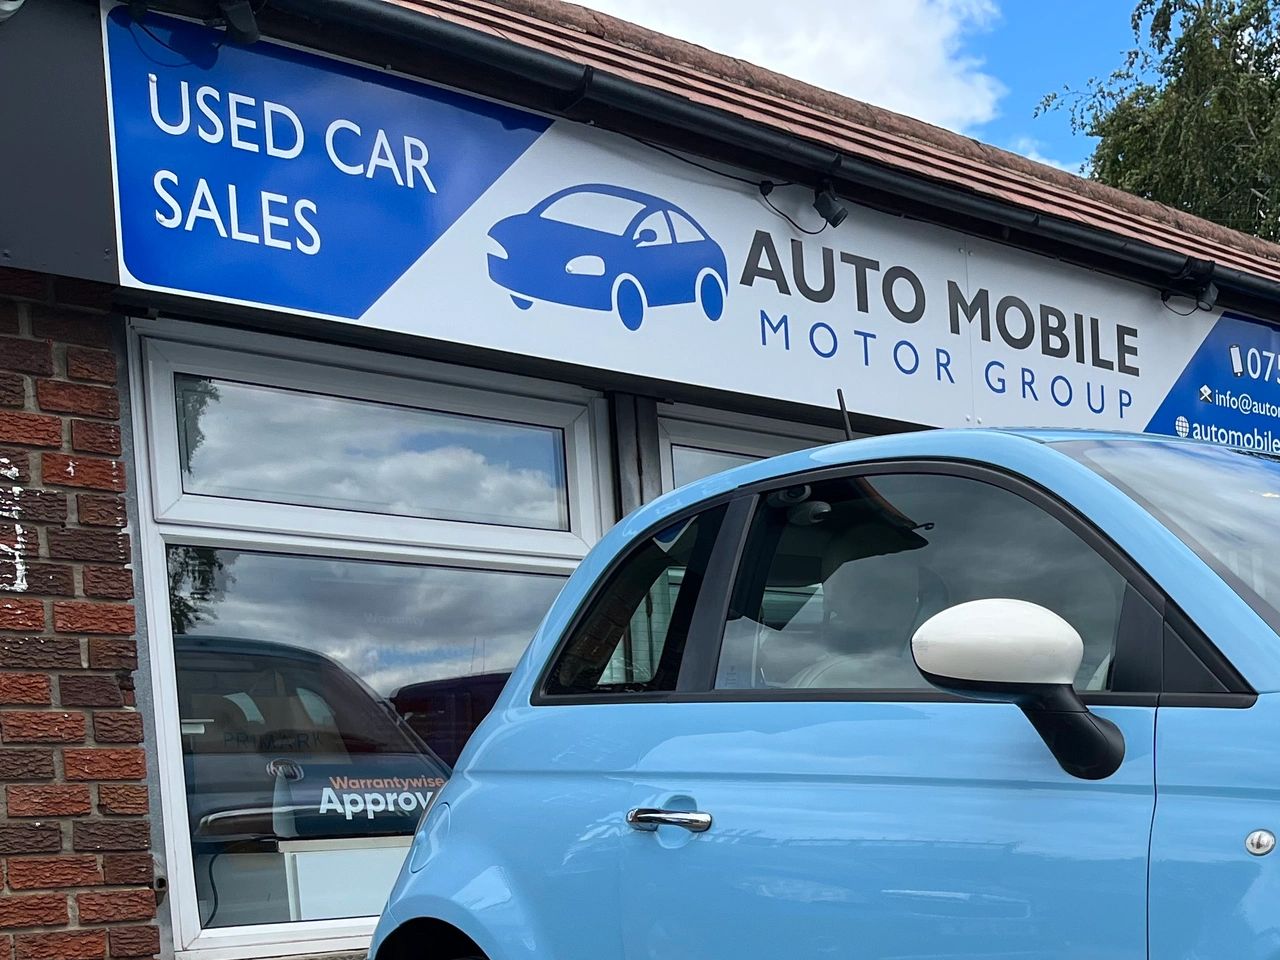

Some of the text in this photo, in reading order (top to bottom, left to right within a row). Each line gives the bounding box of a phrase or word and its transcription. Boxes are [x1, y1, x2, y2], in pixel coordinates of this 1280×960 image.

[148, 73, 437, 194] USED CAR
[153, 169, 321, 255] SALES
[739, 229, 1140, 377] AUTO MOBILE
[759, 309, 1132, 419] MOTOR GROUP
[329, 774, 446, 790] Warrantywise
